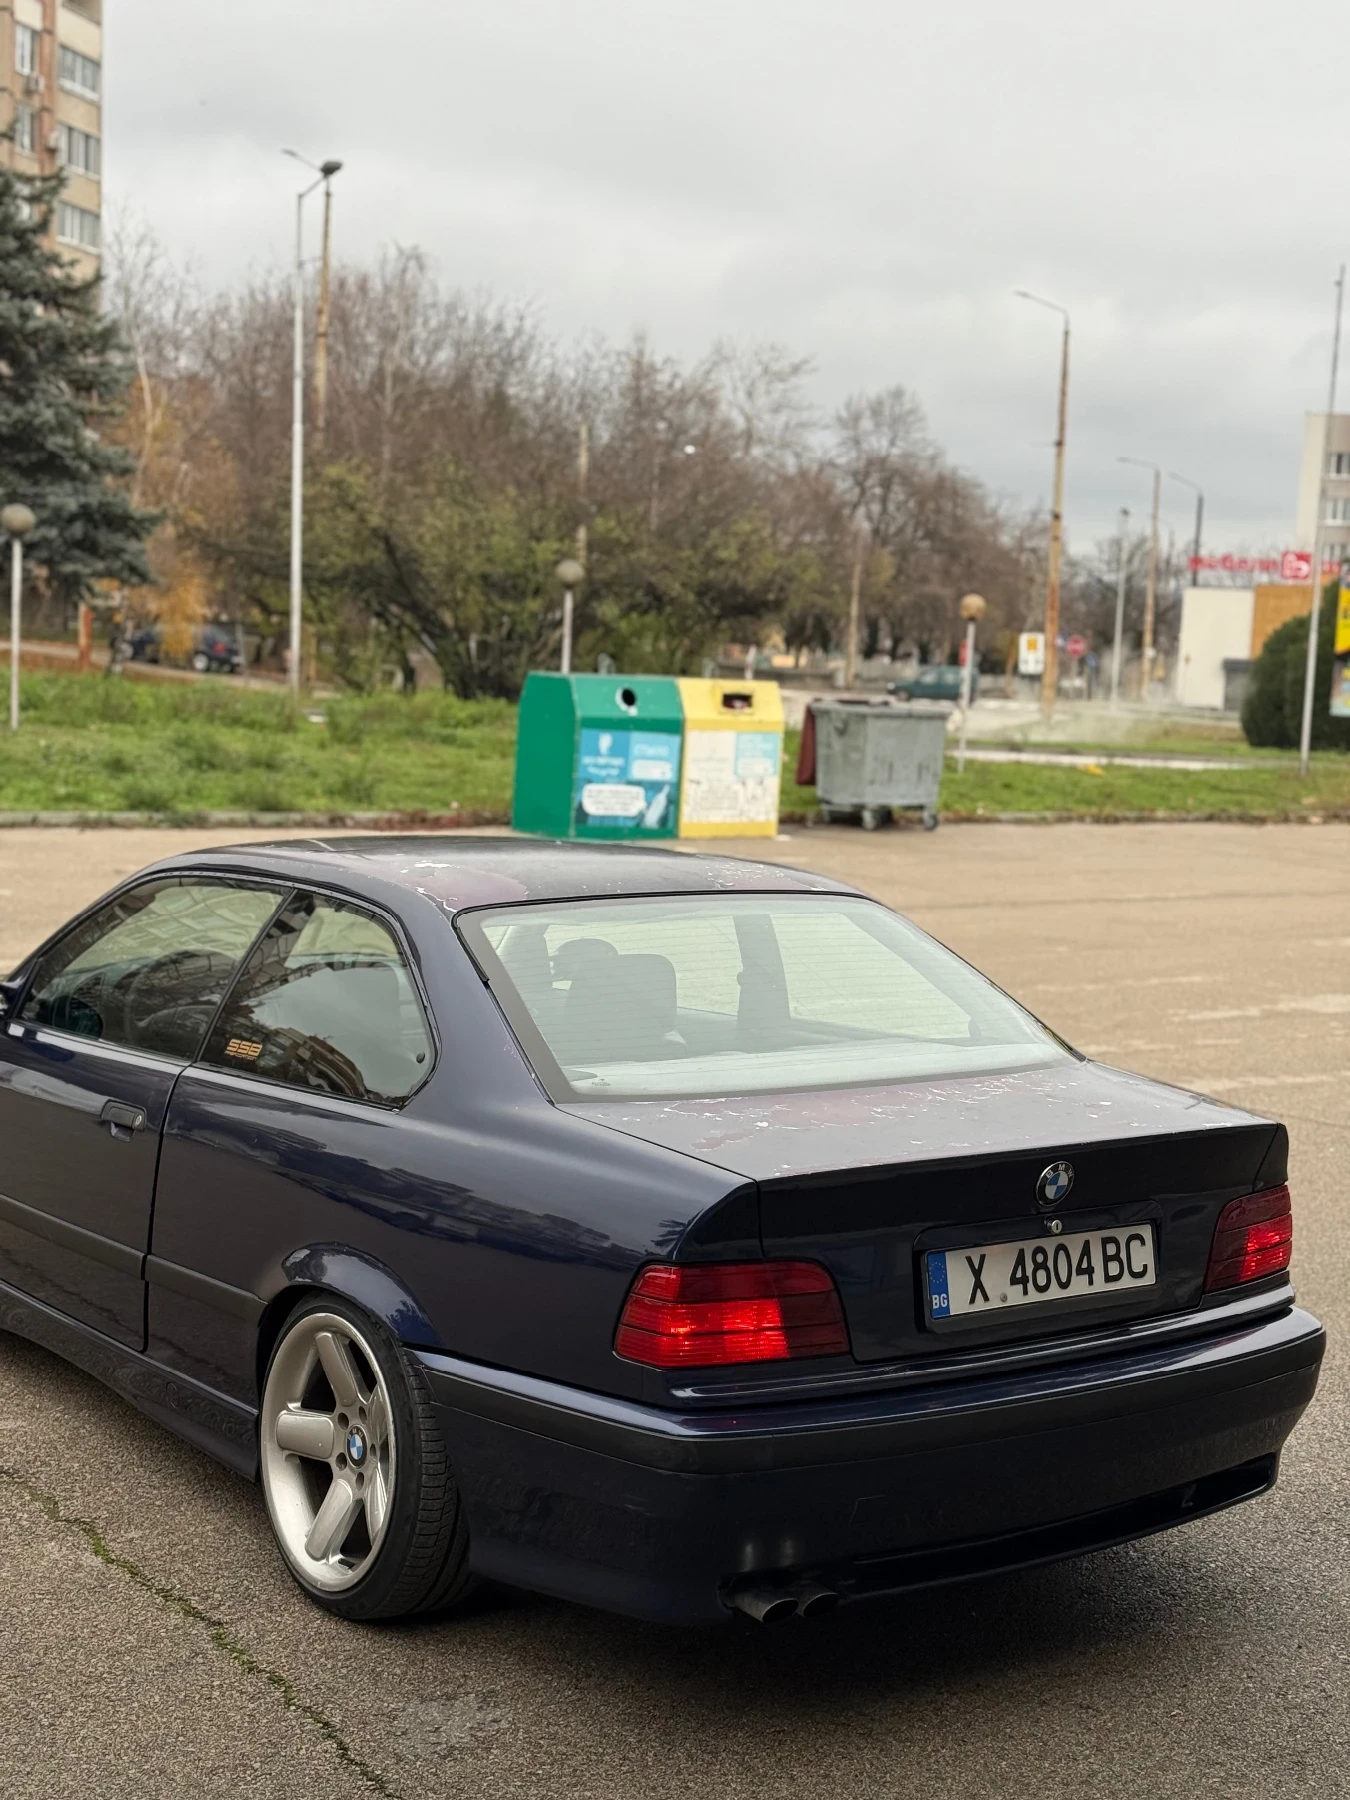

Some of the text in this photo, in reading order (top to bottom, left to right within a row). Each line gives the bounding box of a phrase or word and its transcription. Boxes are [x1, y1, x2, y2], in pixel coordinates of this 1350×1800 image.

[1045, 1163, 1074, 1179] BMW
[965, 1232, 1148, 1305] X 4804 BC
[931, 1293, 948, 1309] BG
